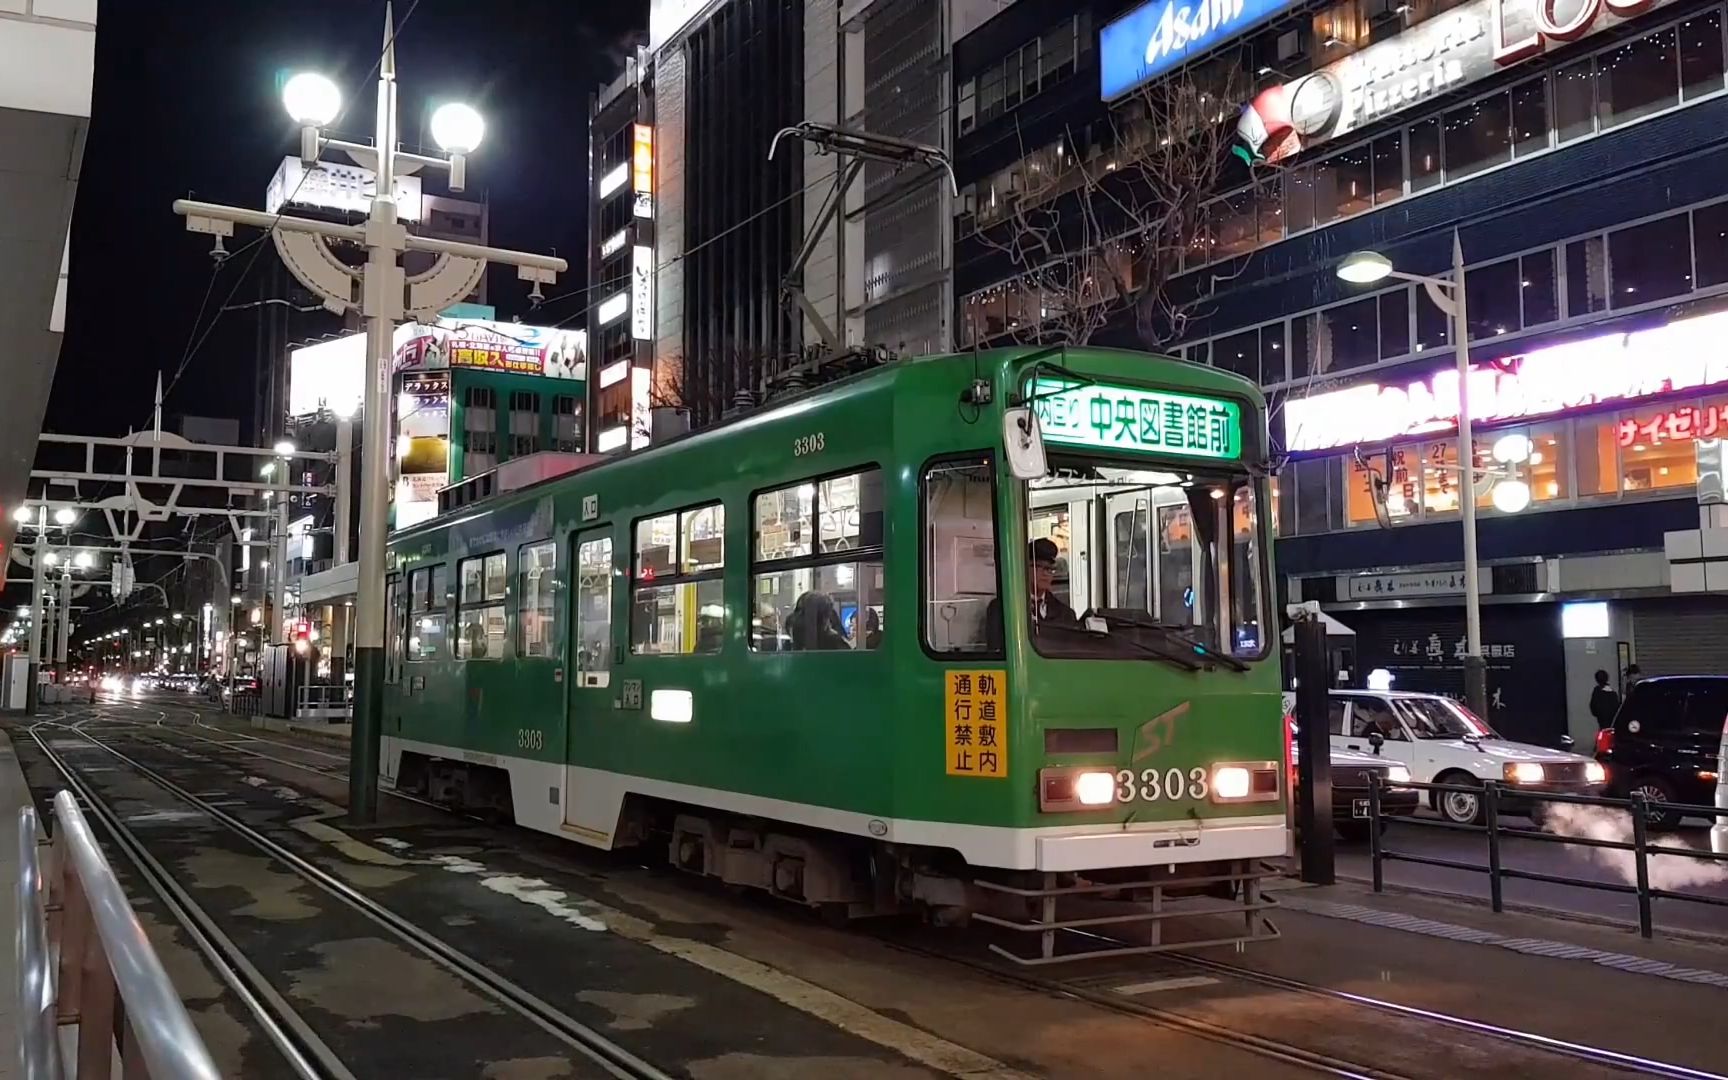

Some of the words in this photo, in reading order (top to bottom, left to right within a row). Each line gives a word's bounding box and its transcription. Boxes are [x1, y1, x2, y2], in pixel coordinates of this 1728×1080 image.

[1346, 57, 1466, 128] Pizzeria
[794, 432, 825, 456] 3303
[1090, 393, 1230, 453] 中央図書館前
[517, 728, 544, 751] 3303
[954, 674, 973, 772] 通行禁止
[978, 674, 997, 773] 軌道敷内
[1116, 767, 1209, 803] 3303
